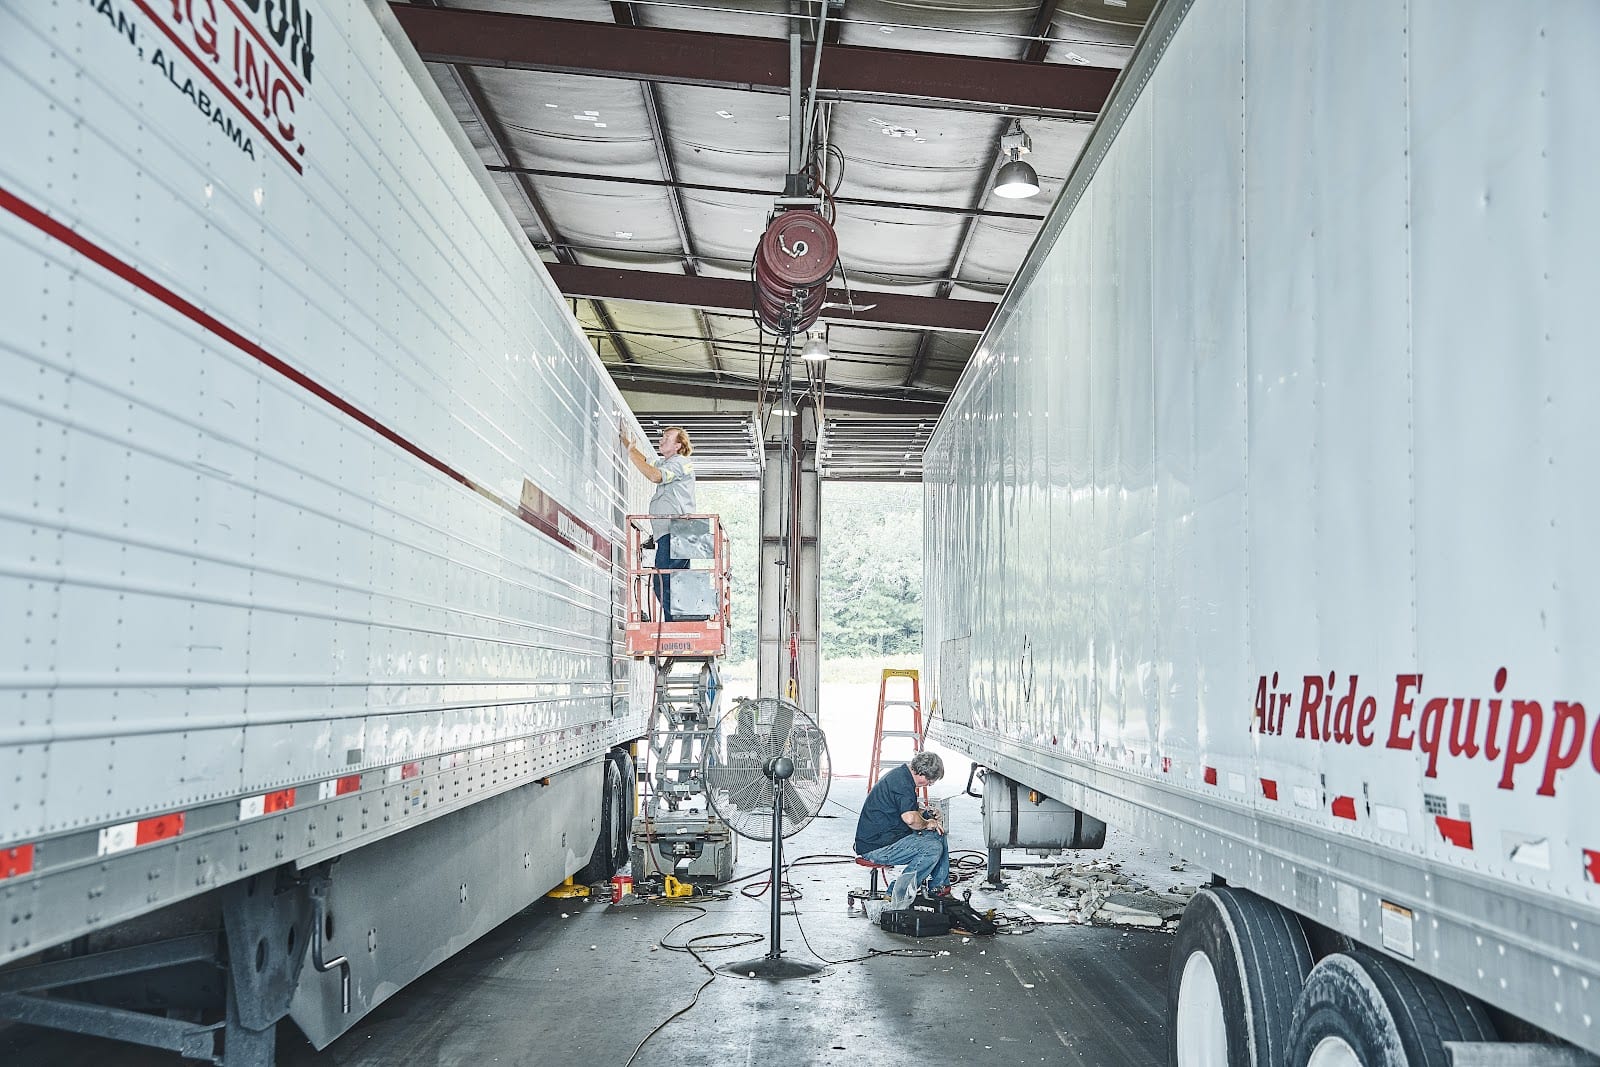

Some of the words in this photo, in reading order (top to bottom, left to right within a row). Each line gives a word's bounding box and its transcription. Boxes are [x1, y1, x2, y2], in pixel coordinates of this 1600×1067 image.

[234, 26, 305, 156] INC.
[243, 0, 314, 85] ON
[152, 48, 255, 161] ALABAMA
[1249, 671, 1292, 736] Air
[1295, 670, 1377, 747] Ride
[1386, 666, 1600, 797] Equipp
